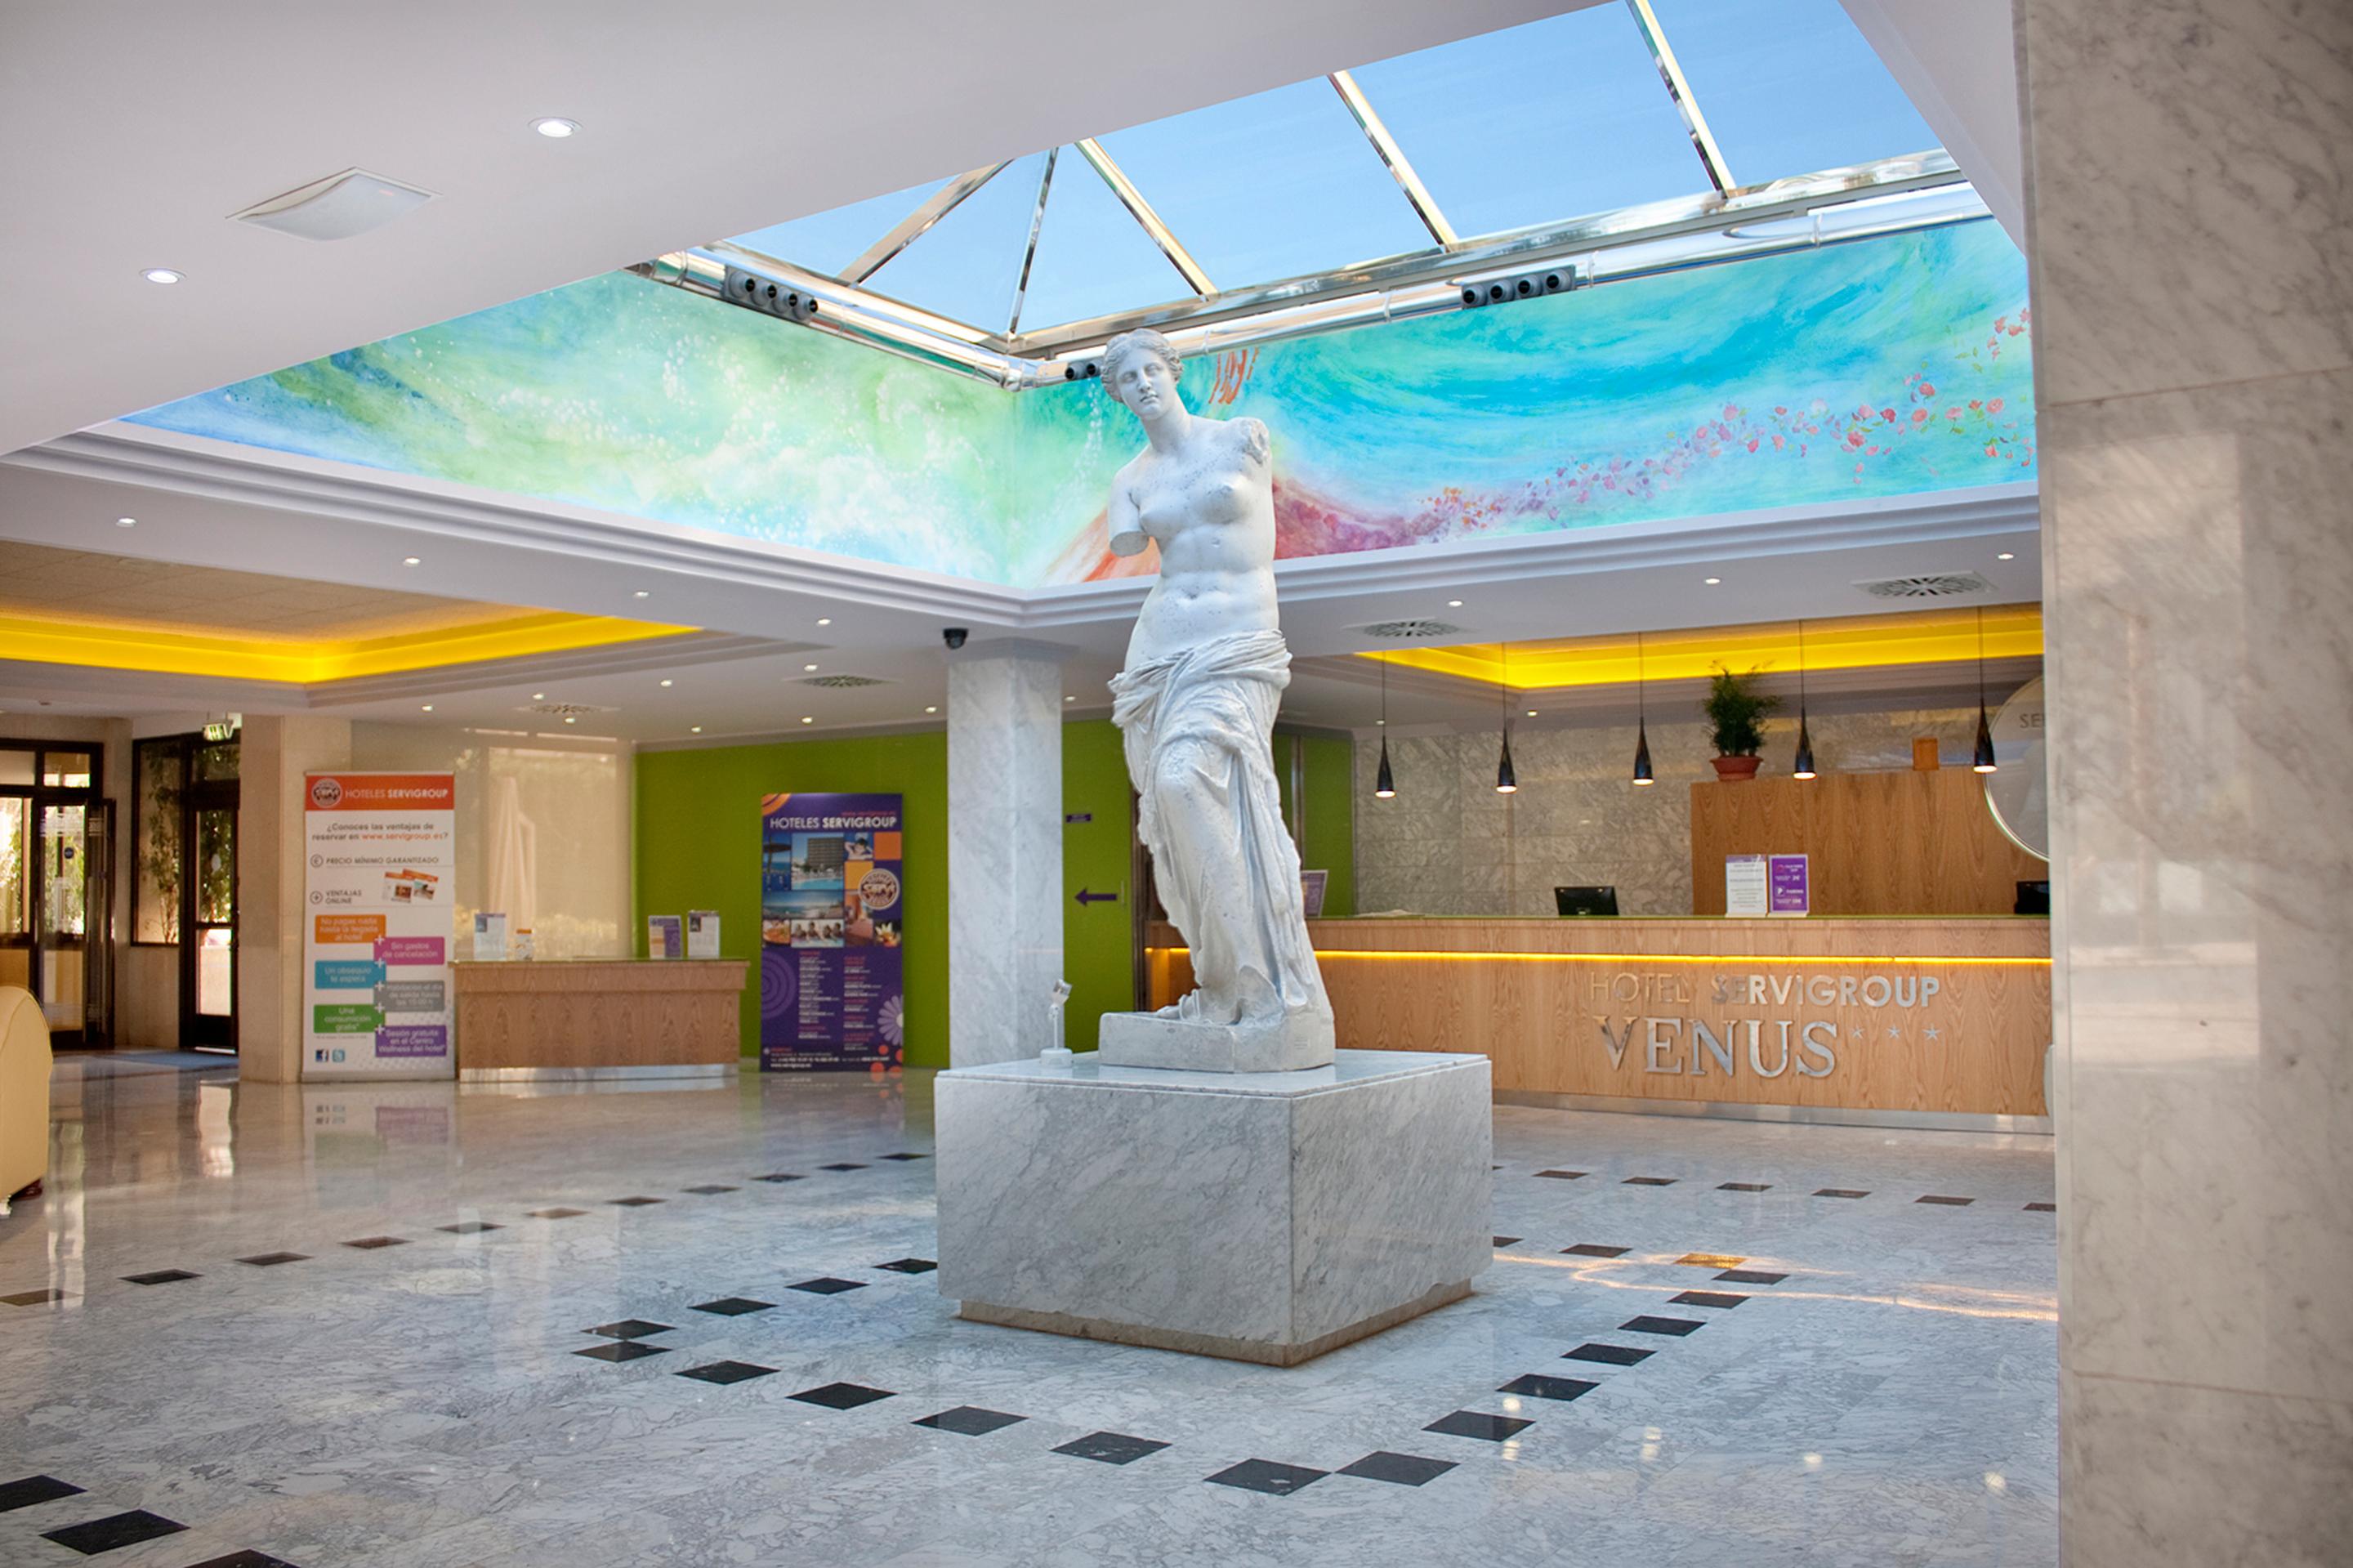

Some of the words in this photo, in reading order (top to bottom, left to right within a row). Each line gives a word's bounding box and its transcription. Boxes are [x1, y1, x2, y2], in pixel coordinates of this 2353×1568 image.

[2019, 712, 2045, 729] SE
[345, 789, 386, 798] HOTELES
[387, 788, 449, 798] SERVIGROUP
[327, 822, 368, 832] ¿Conoces
[371, 822, 383, 830] las
[386, 823, 421, 832] ventajas
[423, 822, 434, 830] de
[770, 818, 819, 829] HOTELES
[822, 816, 897, 829] SERVIGROUP
[386, 856, 439, 864] GARANTIZADO
[1589, 972, 1690, 1005] HOTEL
[1710, 973, 1940, 1008] SERVIGROUP
[1592, 1015, 1838, 1079] VENUS
